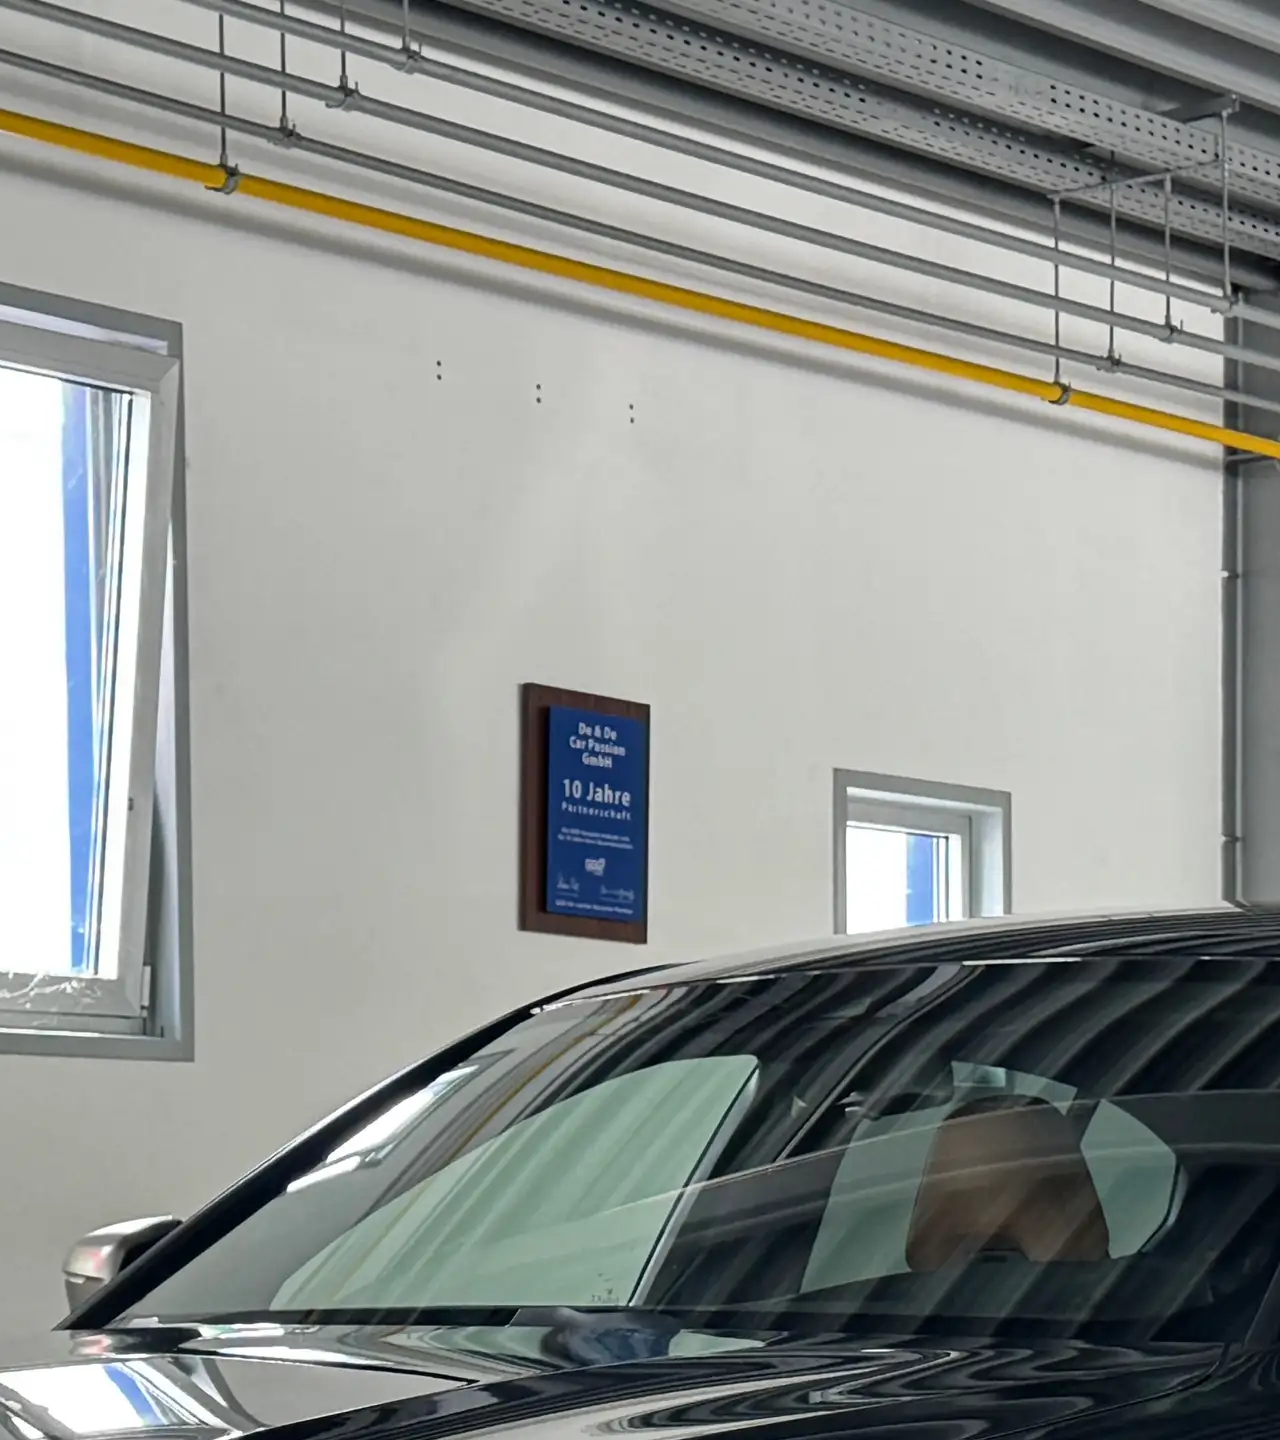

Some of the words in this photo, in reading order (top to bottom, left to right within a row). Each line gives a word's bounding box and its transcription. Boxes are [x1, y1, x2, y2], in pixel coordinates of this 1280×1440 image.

[569, 735, 587, 750] Car
[588, 739, 626, 756] Passion
[581, 752, 612, 768] GmbH
[562, 778, 583, 799] 10
[586, 781, 631, 807] Jahre
[561, 801, 632, 821] Partnerschaft
